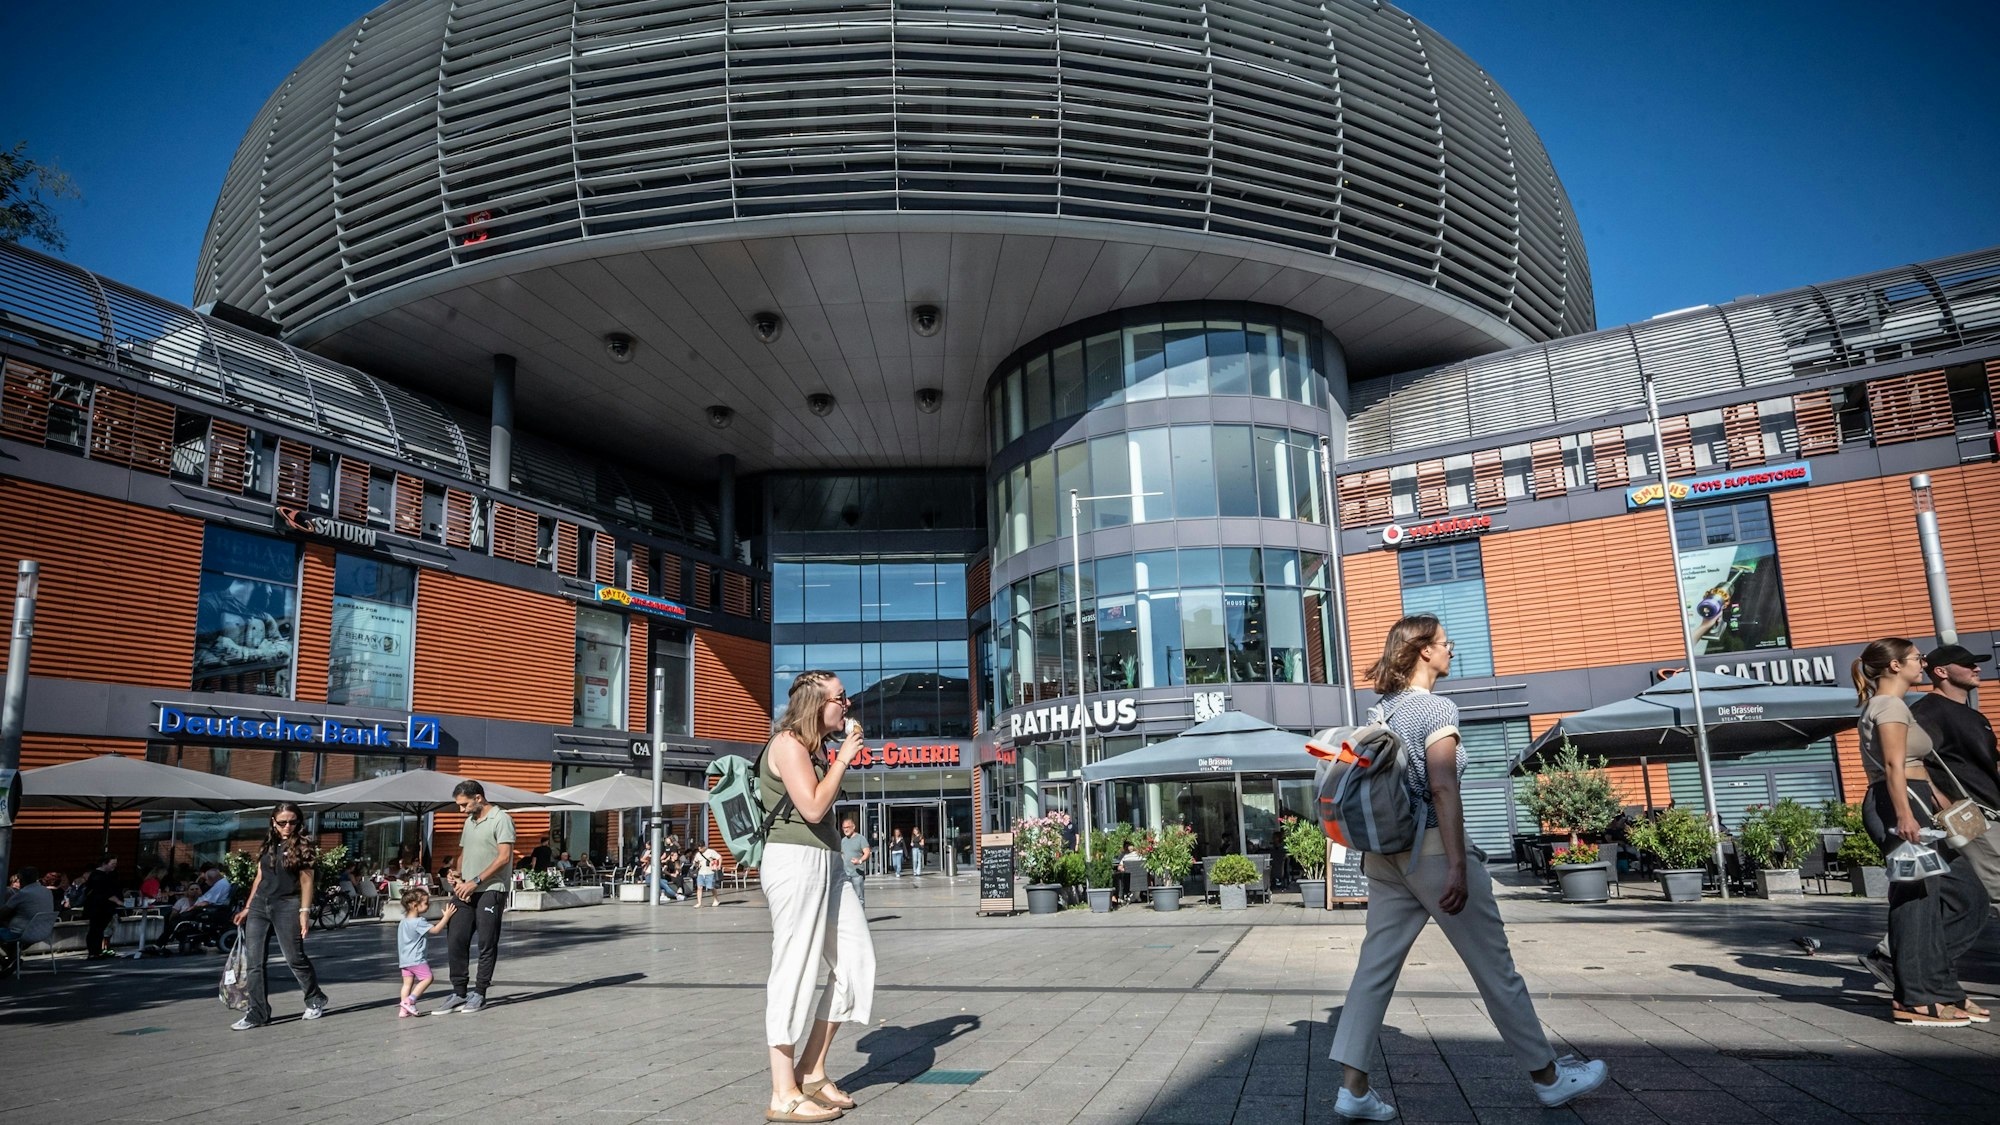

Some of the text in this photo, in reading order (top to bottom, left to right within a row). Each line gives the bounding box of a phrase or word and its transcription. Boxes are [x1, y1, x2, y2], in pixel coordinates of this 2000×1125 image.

[1633, 467, 1806, 504] SMYHS TOYS SUPERSTORES
[313, 516, 377, 547] SATURN
[1408, 515, 1492, 538] vodafone
[601, 588, 630, 605] SMYTHS
[1010, 697, 1138, 738] RATHAUS
[1718, 705, 1764, 716] Die Brasserie
[159, 706, 391, 747] Deutsche Bank
[1198, 757, 1232, 767] Die Brasserie
